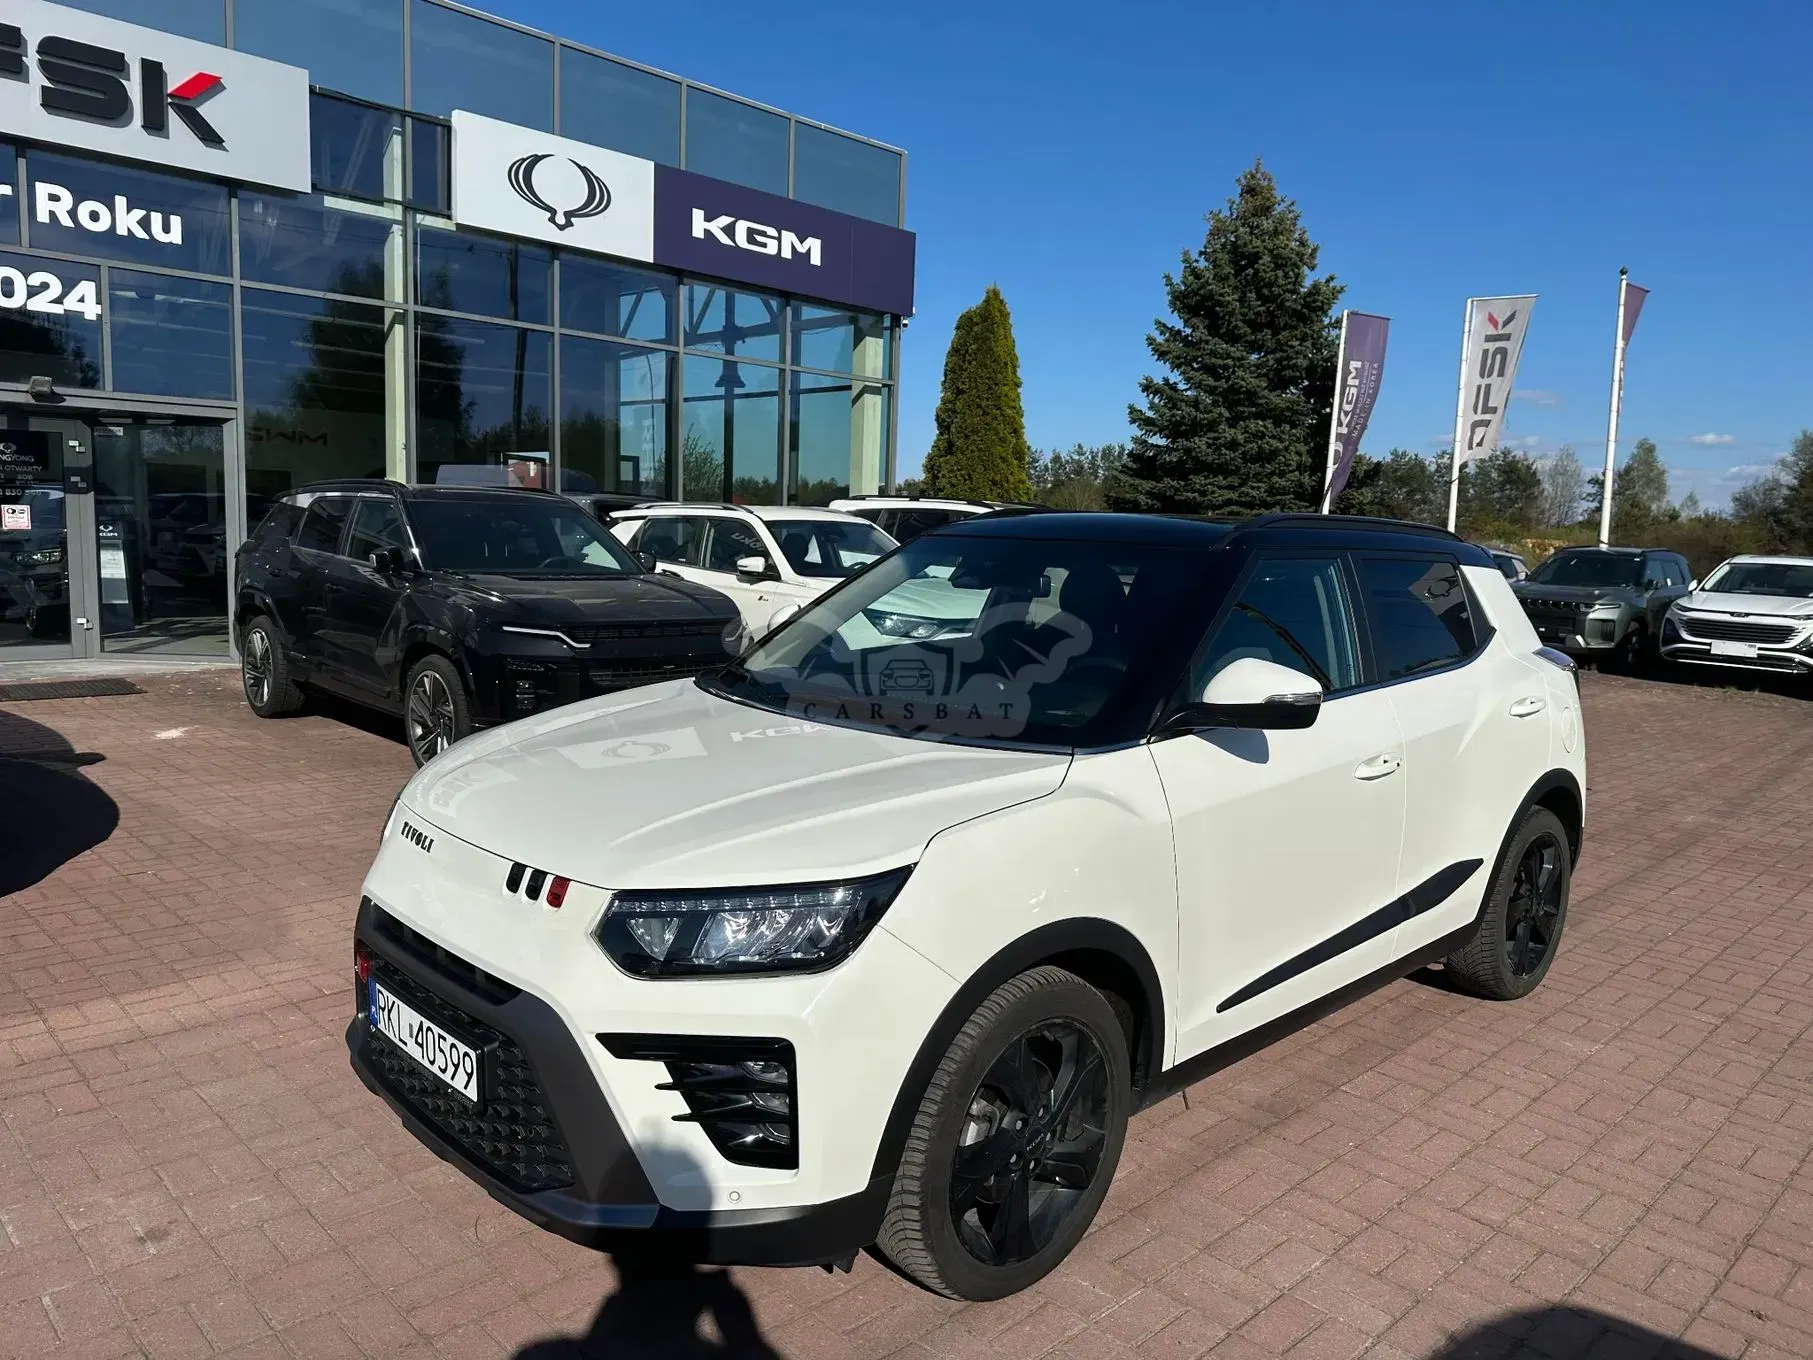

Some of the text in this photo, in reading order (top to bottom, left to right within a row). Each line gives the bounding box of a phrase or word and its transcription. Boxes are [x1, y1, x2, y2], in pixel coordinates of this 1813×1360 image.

[35, 181, 183, 245] Roku
[692, 207, 822, 266] KGM
[1336, 361, 1362, 434] KGM
[1351, 413, 1367, 438] MADE
[1368, 362, 1379, 394] KOREA
[4, 464, 42, 472] OTWARTY
[400, 821, 434, 853] TIVOLI
[377, 988, 475, 1091] RKL 40599
